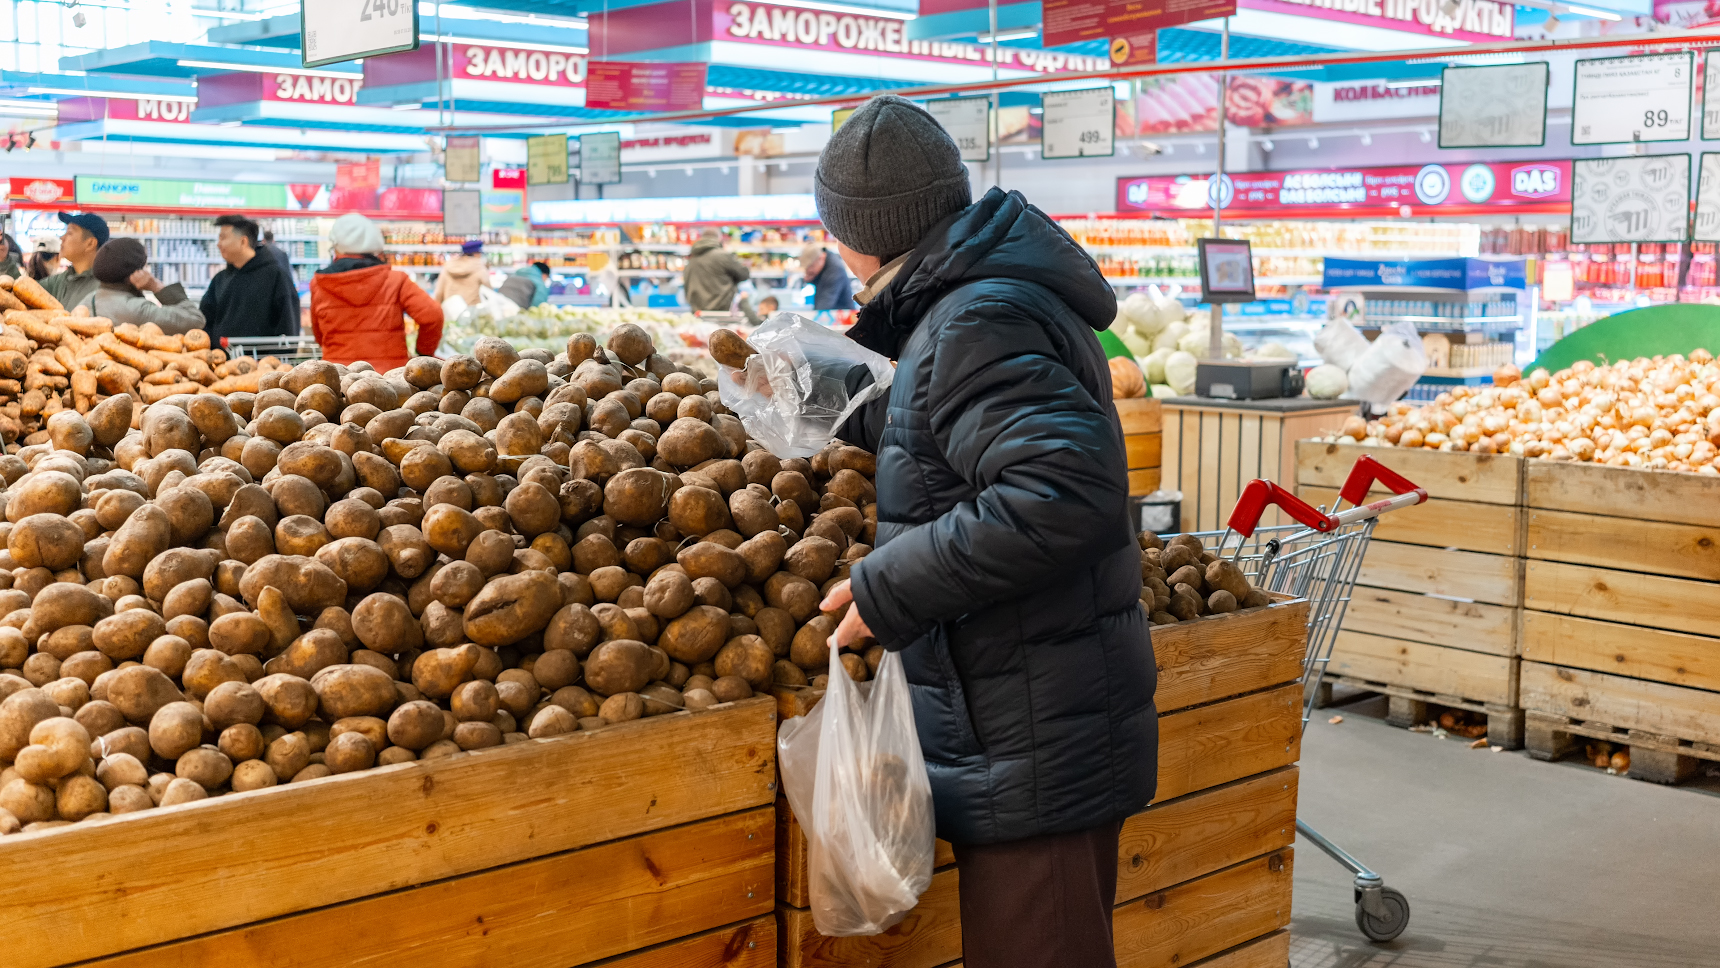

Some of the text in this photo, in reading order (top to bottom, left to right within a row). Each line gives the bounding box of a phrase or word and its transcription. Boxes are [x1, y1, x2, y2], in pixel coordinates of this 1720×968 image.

[1384, 0, 1513, 37] ПРОДУКТЫ
[465, 46, 584, 83] ЗАМОРО
[1674, 67, 1681, 78] 8
[1644, 109, 1669, 128] 89
[1079, 130, 1100, 144] 499
[1515, 168, 1556, 194] DAS
